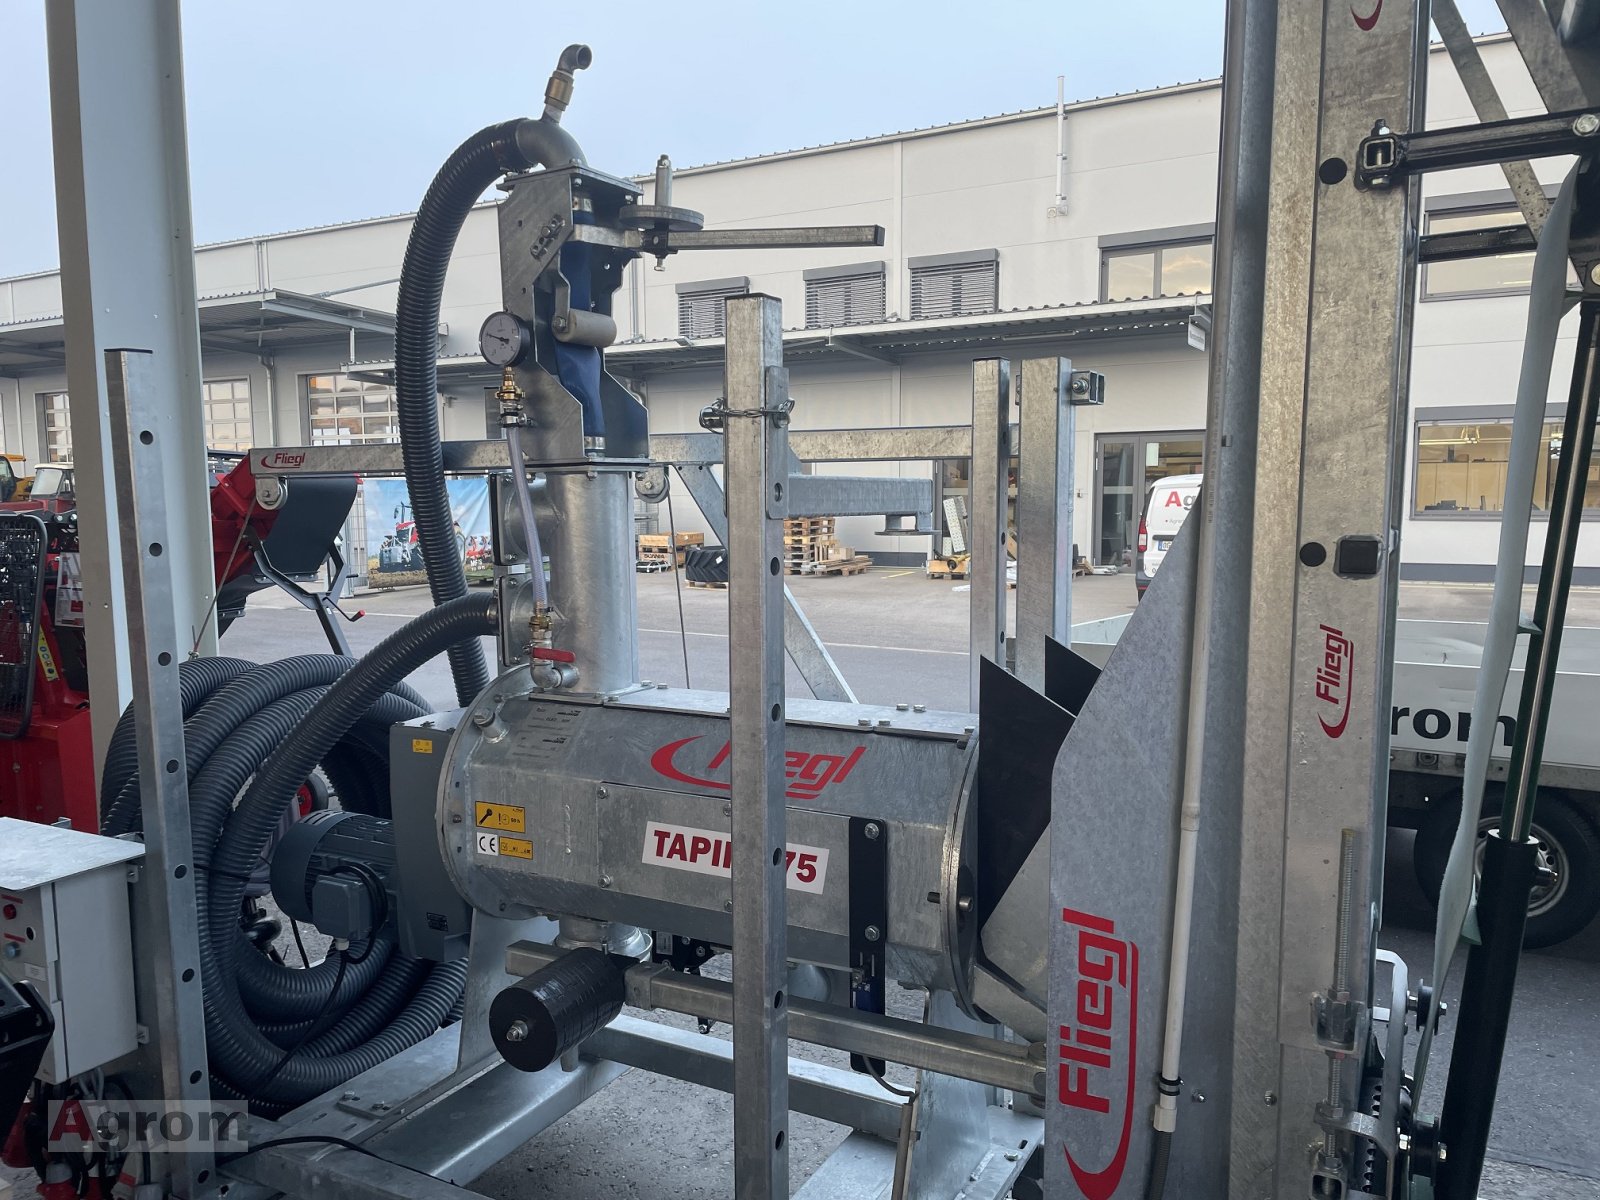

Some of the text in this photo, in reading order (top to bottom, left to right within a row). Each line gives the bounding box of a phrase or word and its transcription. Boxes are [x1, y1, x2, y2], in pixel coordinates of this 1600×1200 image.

[274, 452, 306, 466] Fliegl
[1316, 623, 1348, 705] Fliegl
[1059, 907, 1127, 1114] Fliegl
